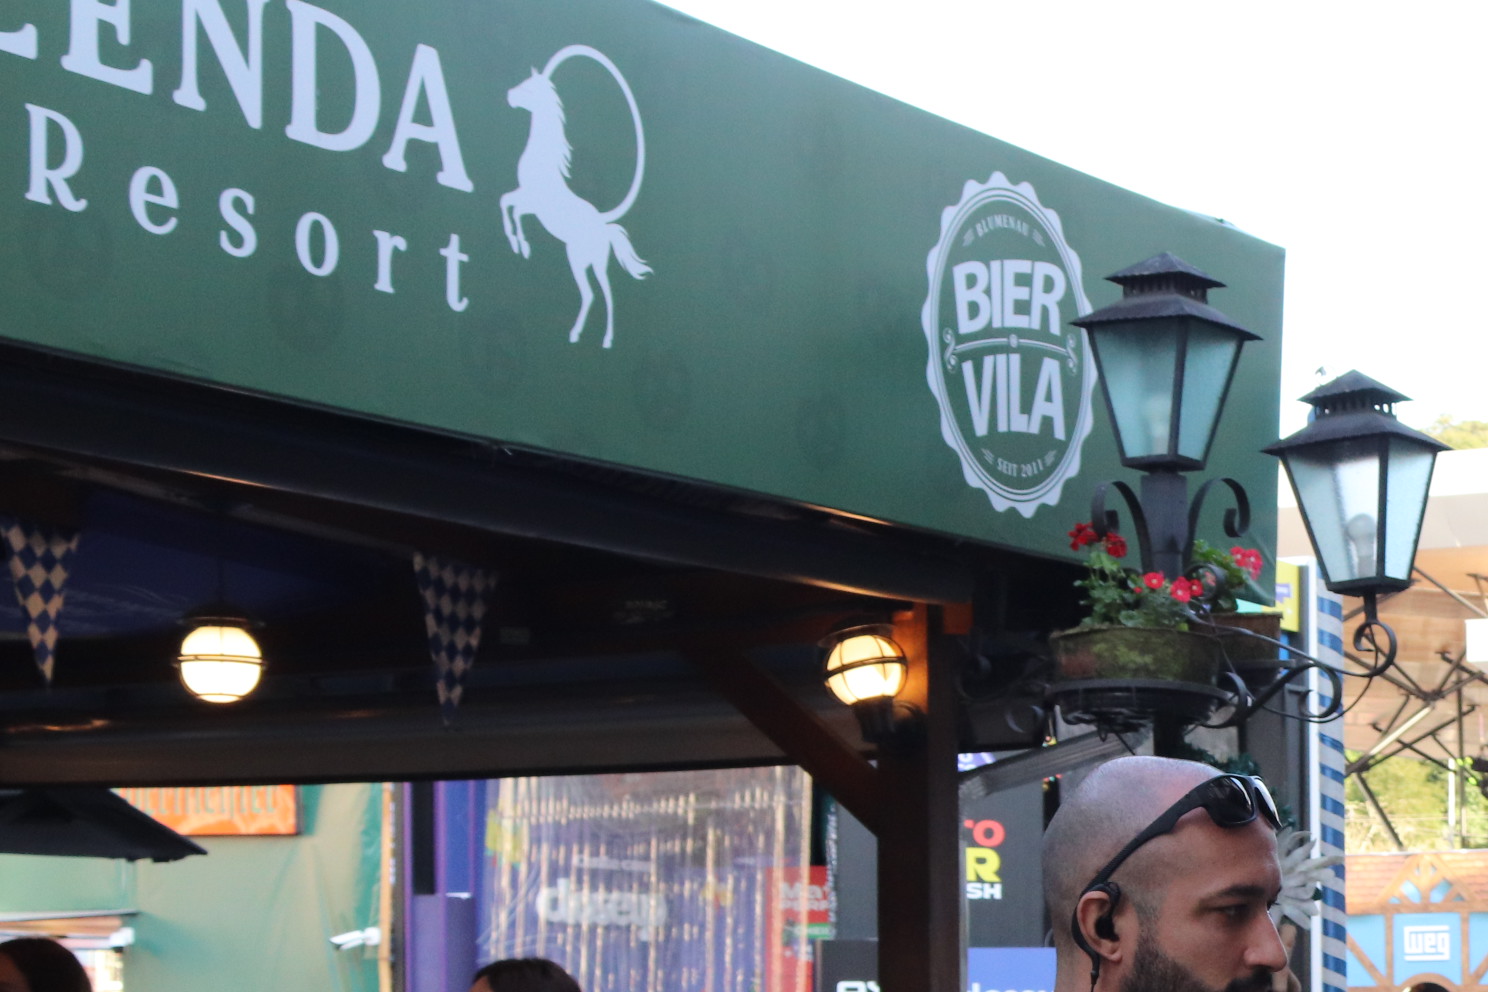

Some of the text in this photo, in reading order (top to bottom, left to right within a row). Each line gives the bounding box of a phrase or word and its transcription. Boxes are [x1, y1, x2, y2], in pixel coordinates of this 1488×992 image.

[24, 103, 469, 311] Resort
[975, 214, 1029, 237] BLUMENAU
[953, 258, 1066, 336] BIER
[961, 353, 1066, 441] VILA
